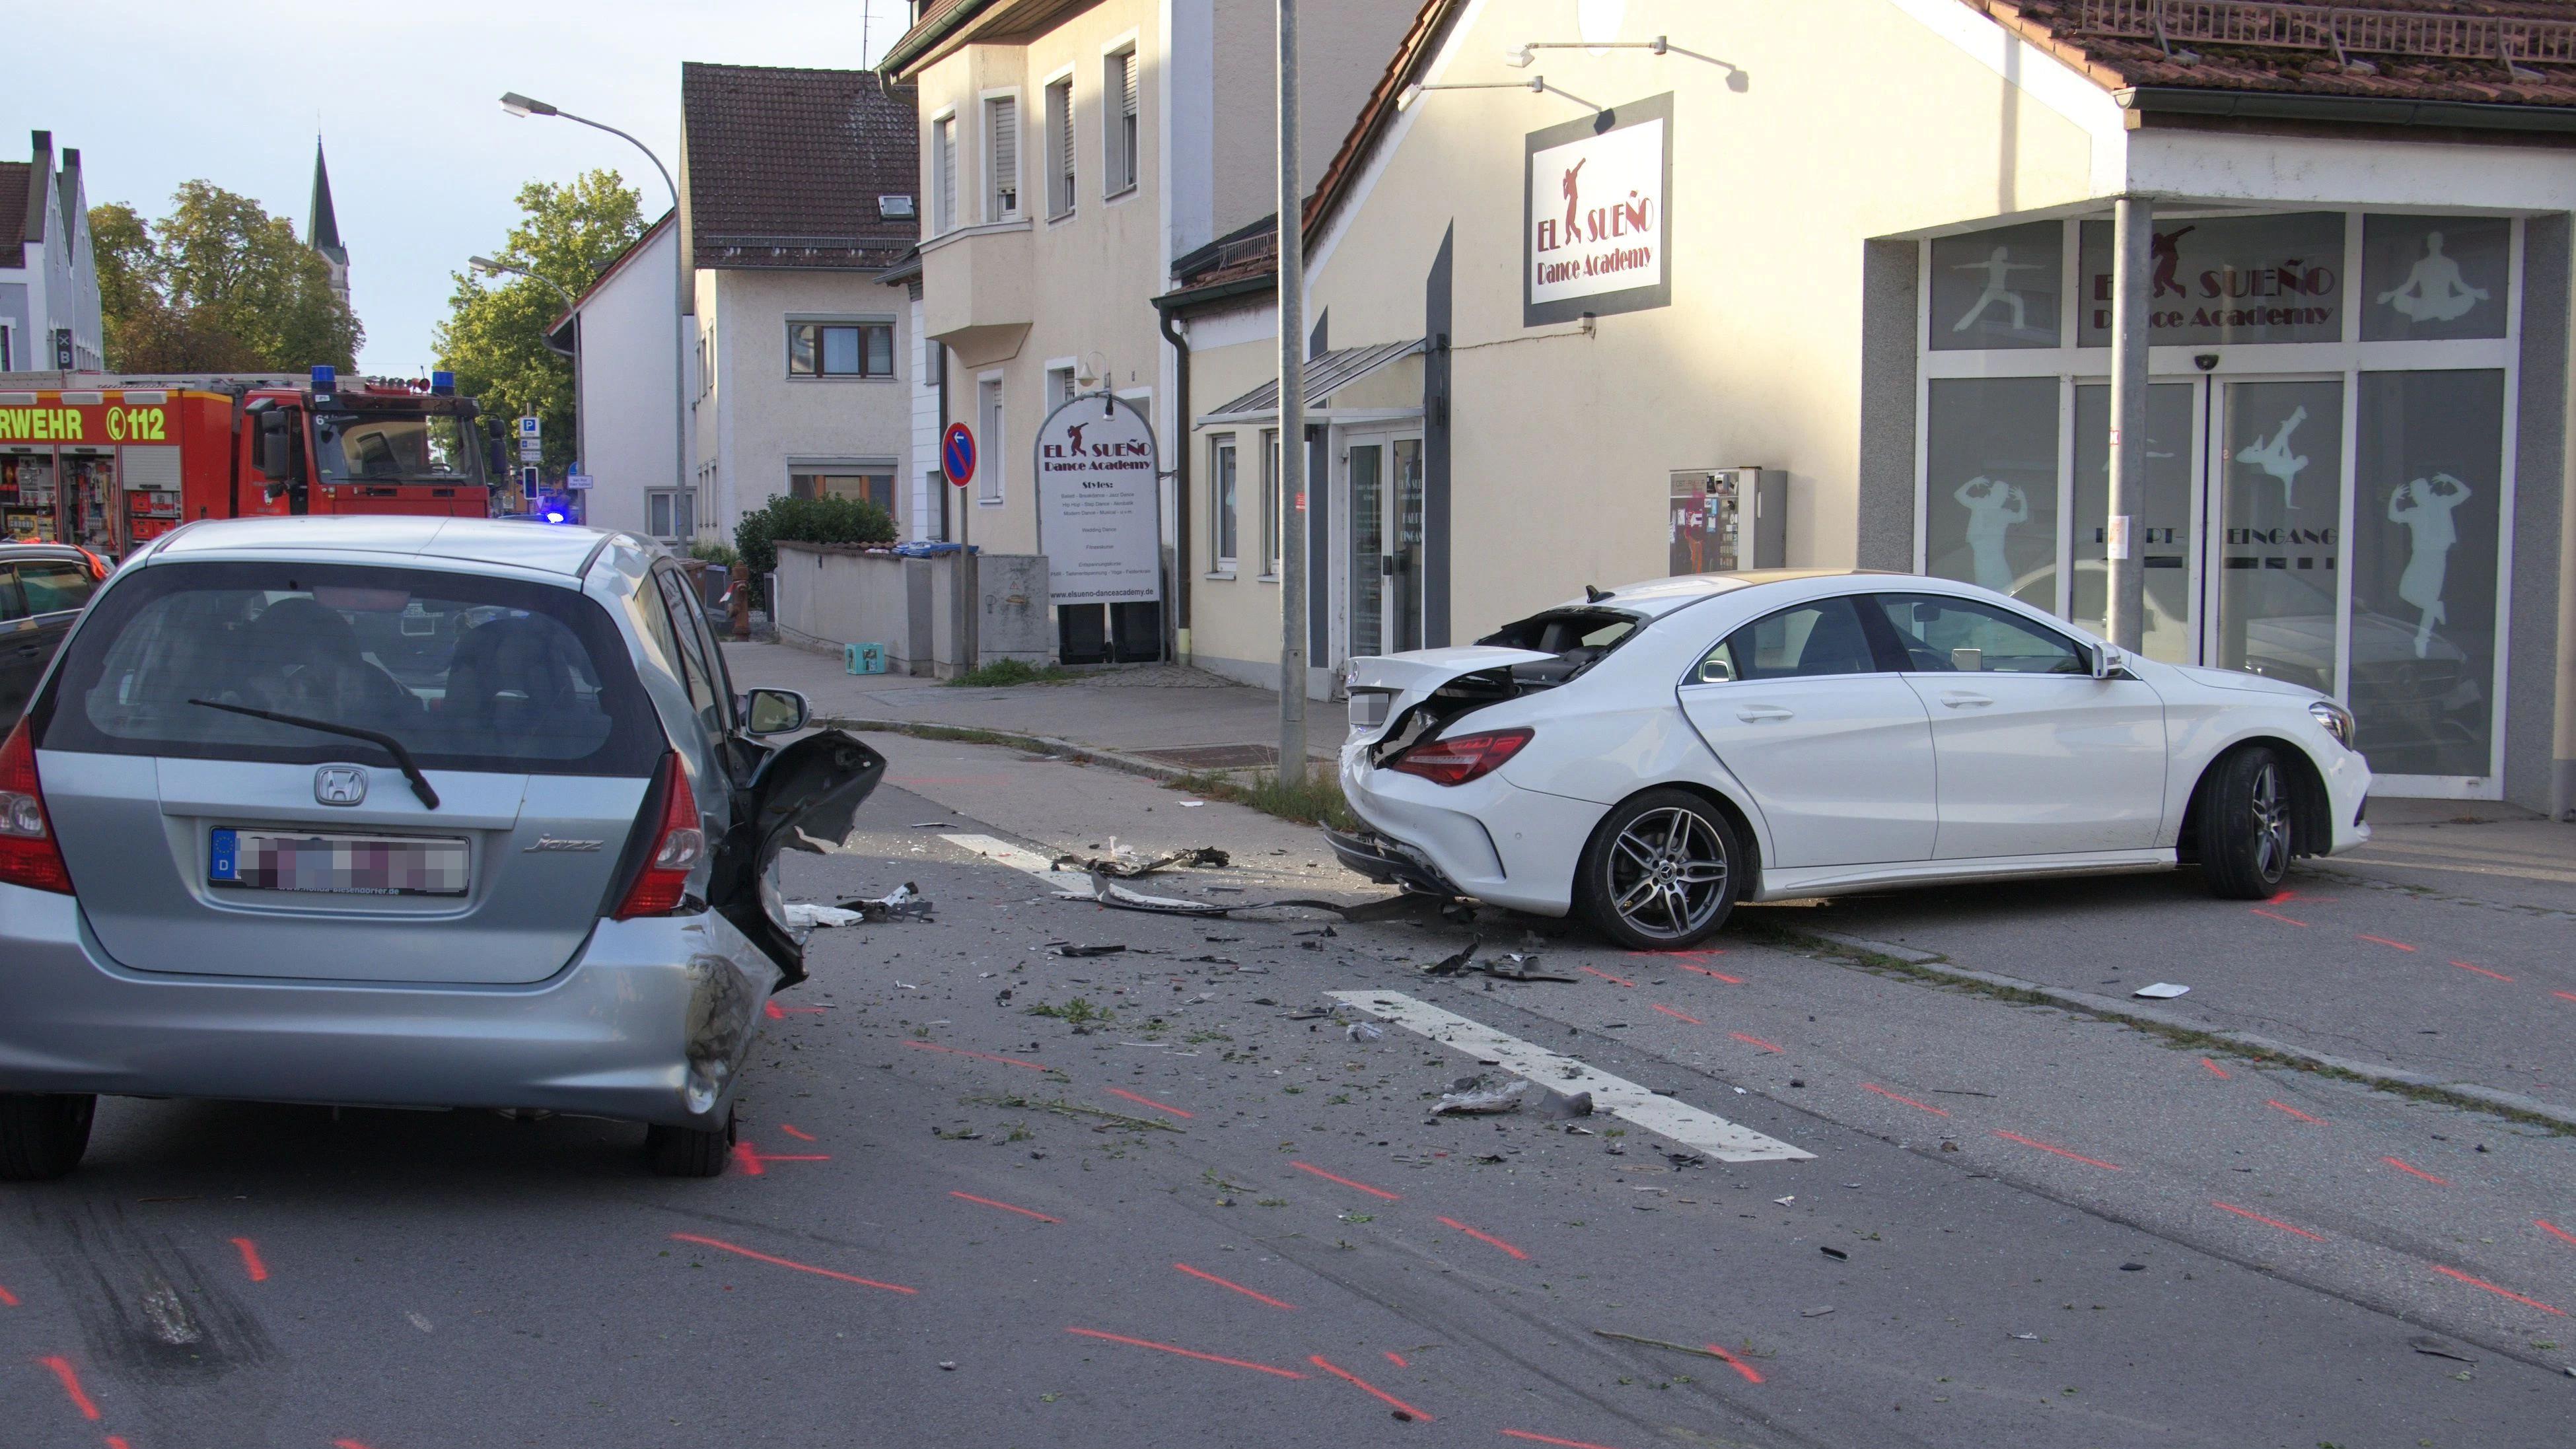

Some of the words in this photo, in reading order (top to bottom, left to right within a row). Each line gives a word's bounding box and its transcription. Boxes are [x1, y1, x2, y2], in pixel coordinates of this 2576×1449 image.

[1538, 219, 1560, 252] EL
[1588, 190, 1653, 242] SUEÑO
[1538, 259, 1580, 285] Dance
[1583, 246, 1653, 277] Academy
[2199, 259, 2335, 299] SUEÑO
[2094, 309, 2184, 329] Dce
[2188, 306, 2334, 328] Academy
[127, 408, 165, 440] 112
[526, 421, 533, 430] P
[1044, 445, 1067, 458] EL
[1092, 439, 1152, 458] SUEÑO
[1044, 462, 1086, 472] Dance
[1089, 460, 1151, 471] Academy
[2096, 528, 2184, 544] HPT-
[2227, 528, 2339, 545] EINGANG
[1050, 588, 1154, 598] www.elsueno-danceacademy.de
[219, 860, 229, 870] D
